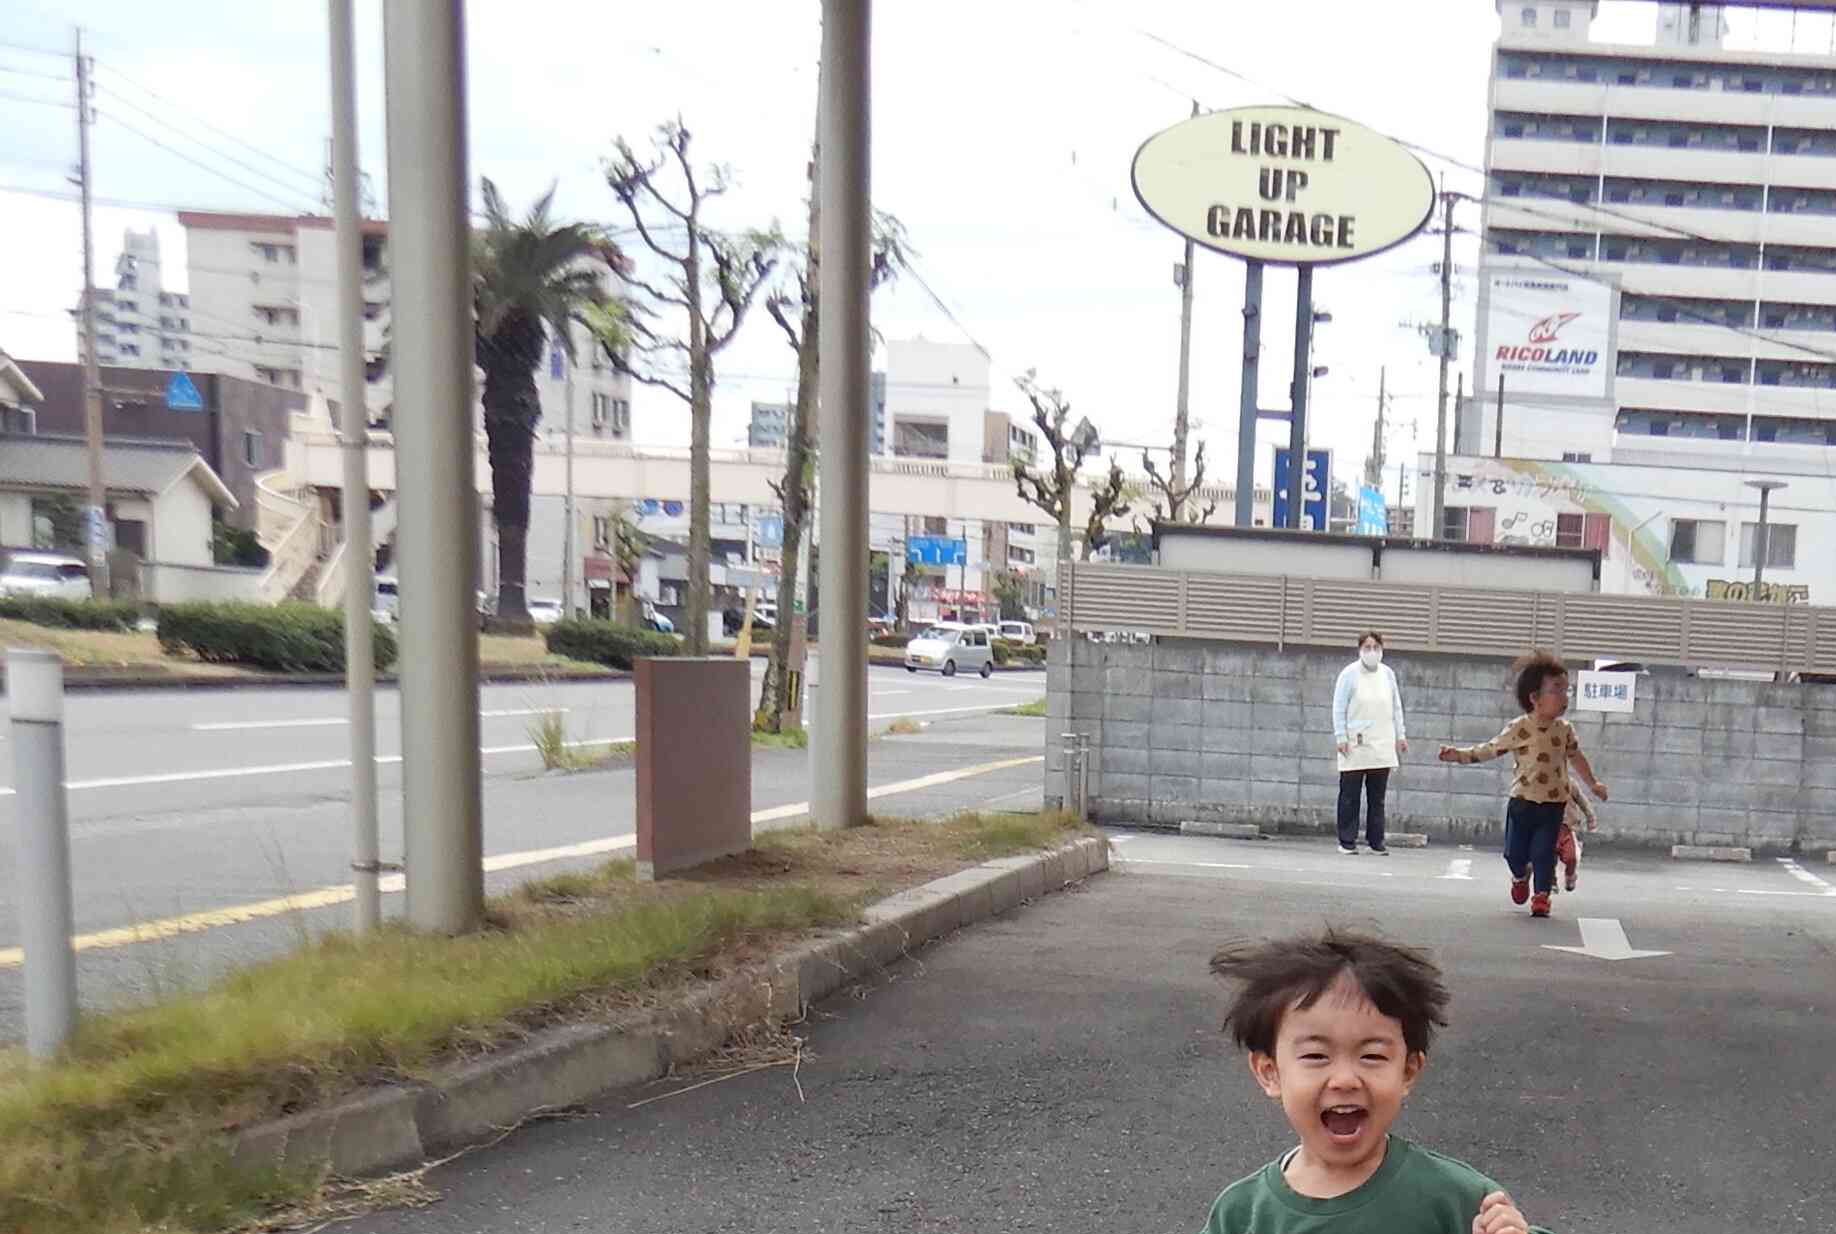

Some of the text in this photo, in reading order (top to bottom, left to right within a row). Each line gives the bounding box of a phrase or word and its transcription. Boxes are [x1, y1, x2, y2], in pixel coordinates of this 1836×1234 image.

[1230, 119, 1341, 162] LIGHT
[1258, 166, 1309, 202] UP
[1206, 203, 1356, 249] GARAGE
[1496, 345, 1598, 364] RICOLAND
[1584, 683, 1628, 700] 駐車場
